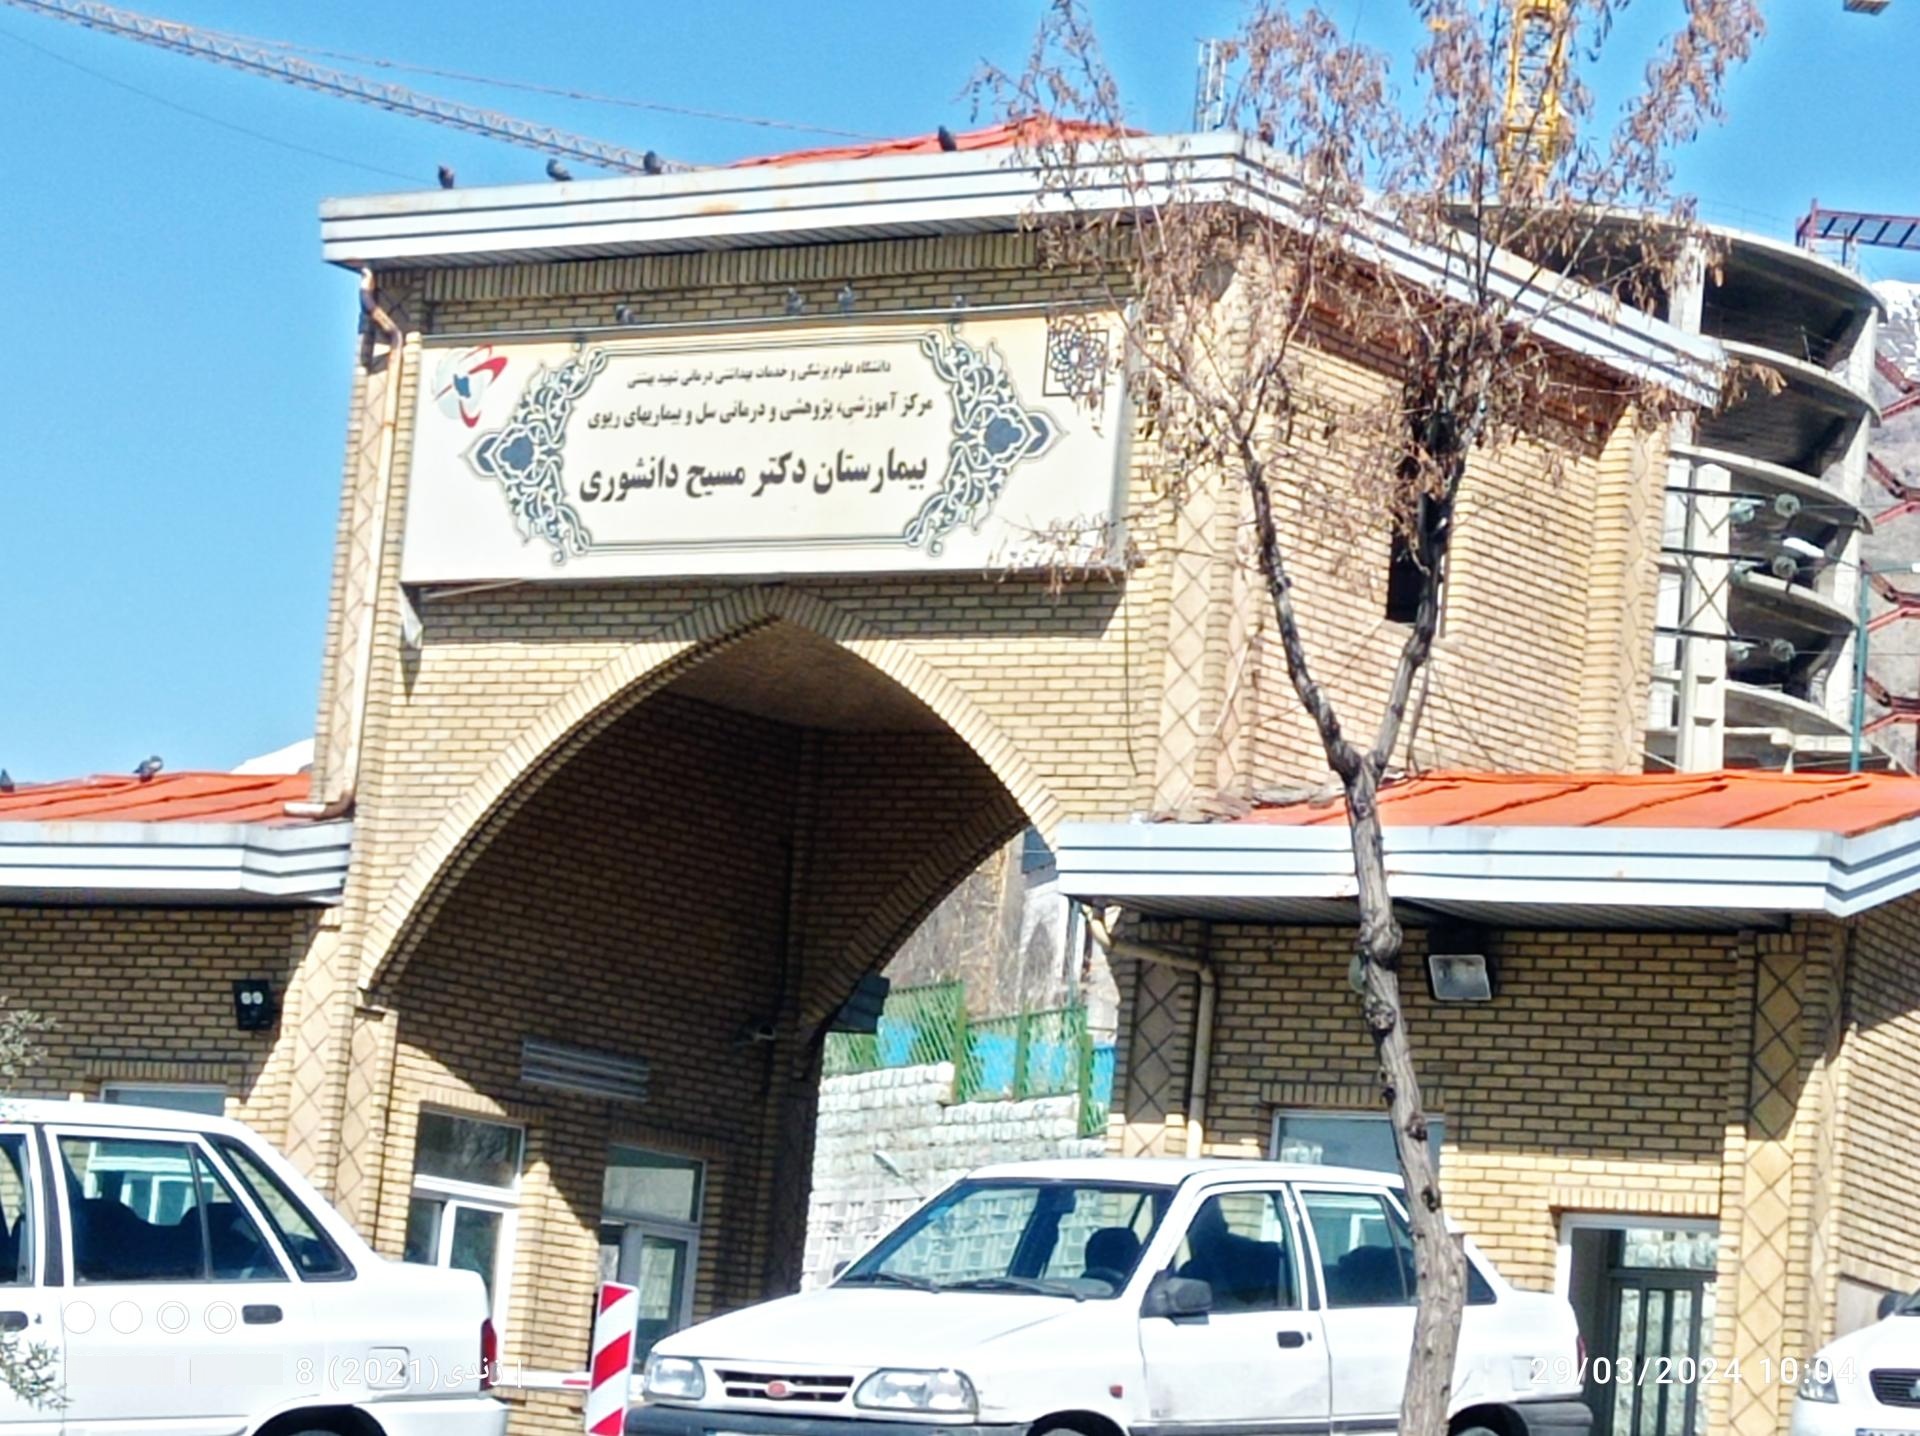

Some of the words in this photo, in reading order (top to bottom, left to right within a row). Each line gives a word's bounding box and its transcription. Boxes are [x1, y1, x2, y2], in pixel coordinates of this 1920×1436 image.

[695, 402, 716, 424] سل
[719, 401, 765, 423] درمانی
[769, 406, 776, 422] و
[780, 398, 833, 420] پژوهشی
[901, 393, 933, 418] مرکز
[587, 411, 620, 430] ریوی
[685, 410, 692, 426] و
[579, 454, 679, 503] دانشوری
[685, 464, 745, 498] مسیح
[751, 450, 806, 498] دکتر
[813, 447, 927, 494] بیمارستان
